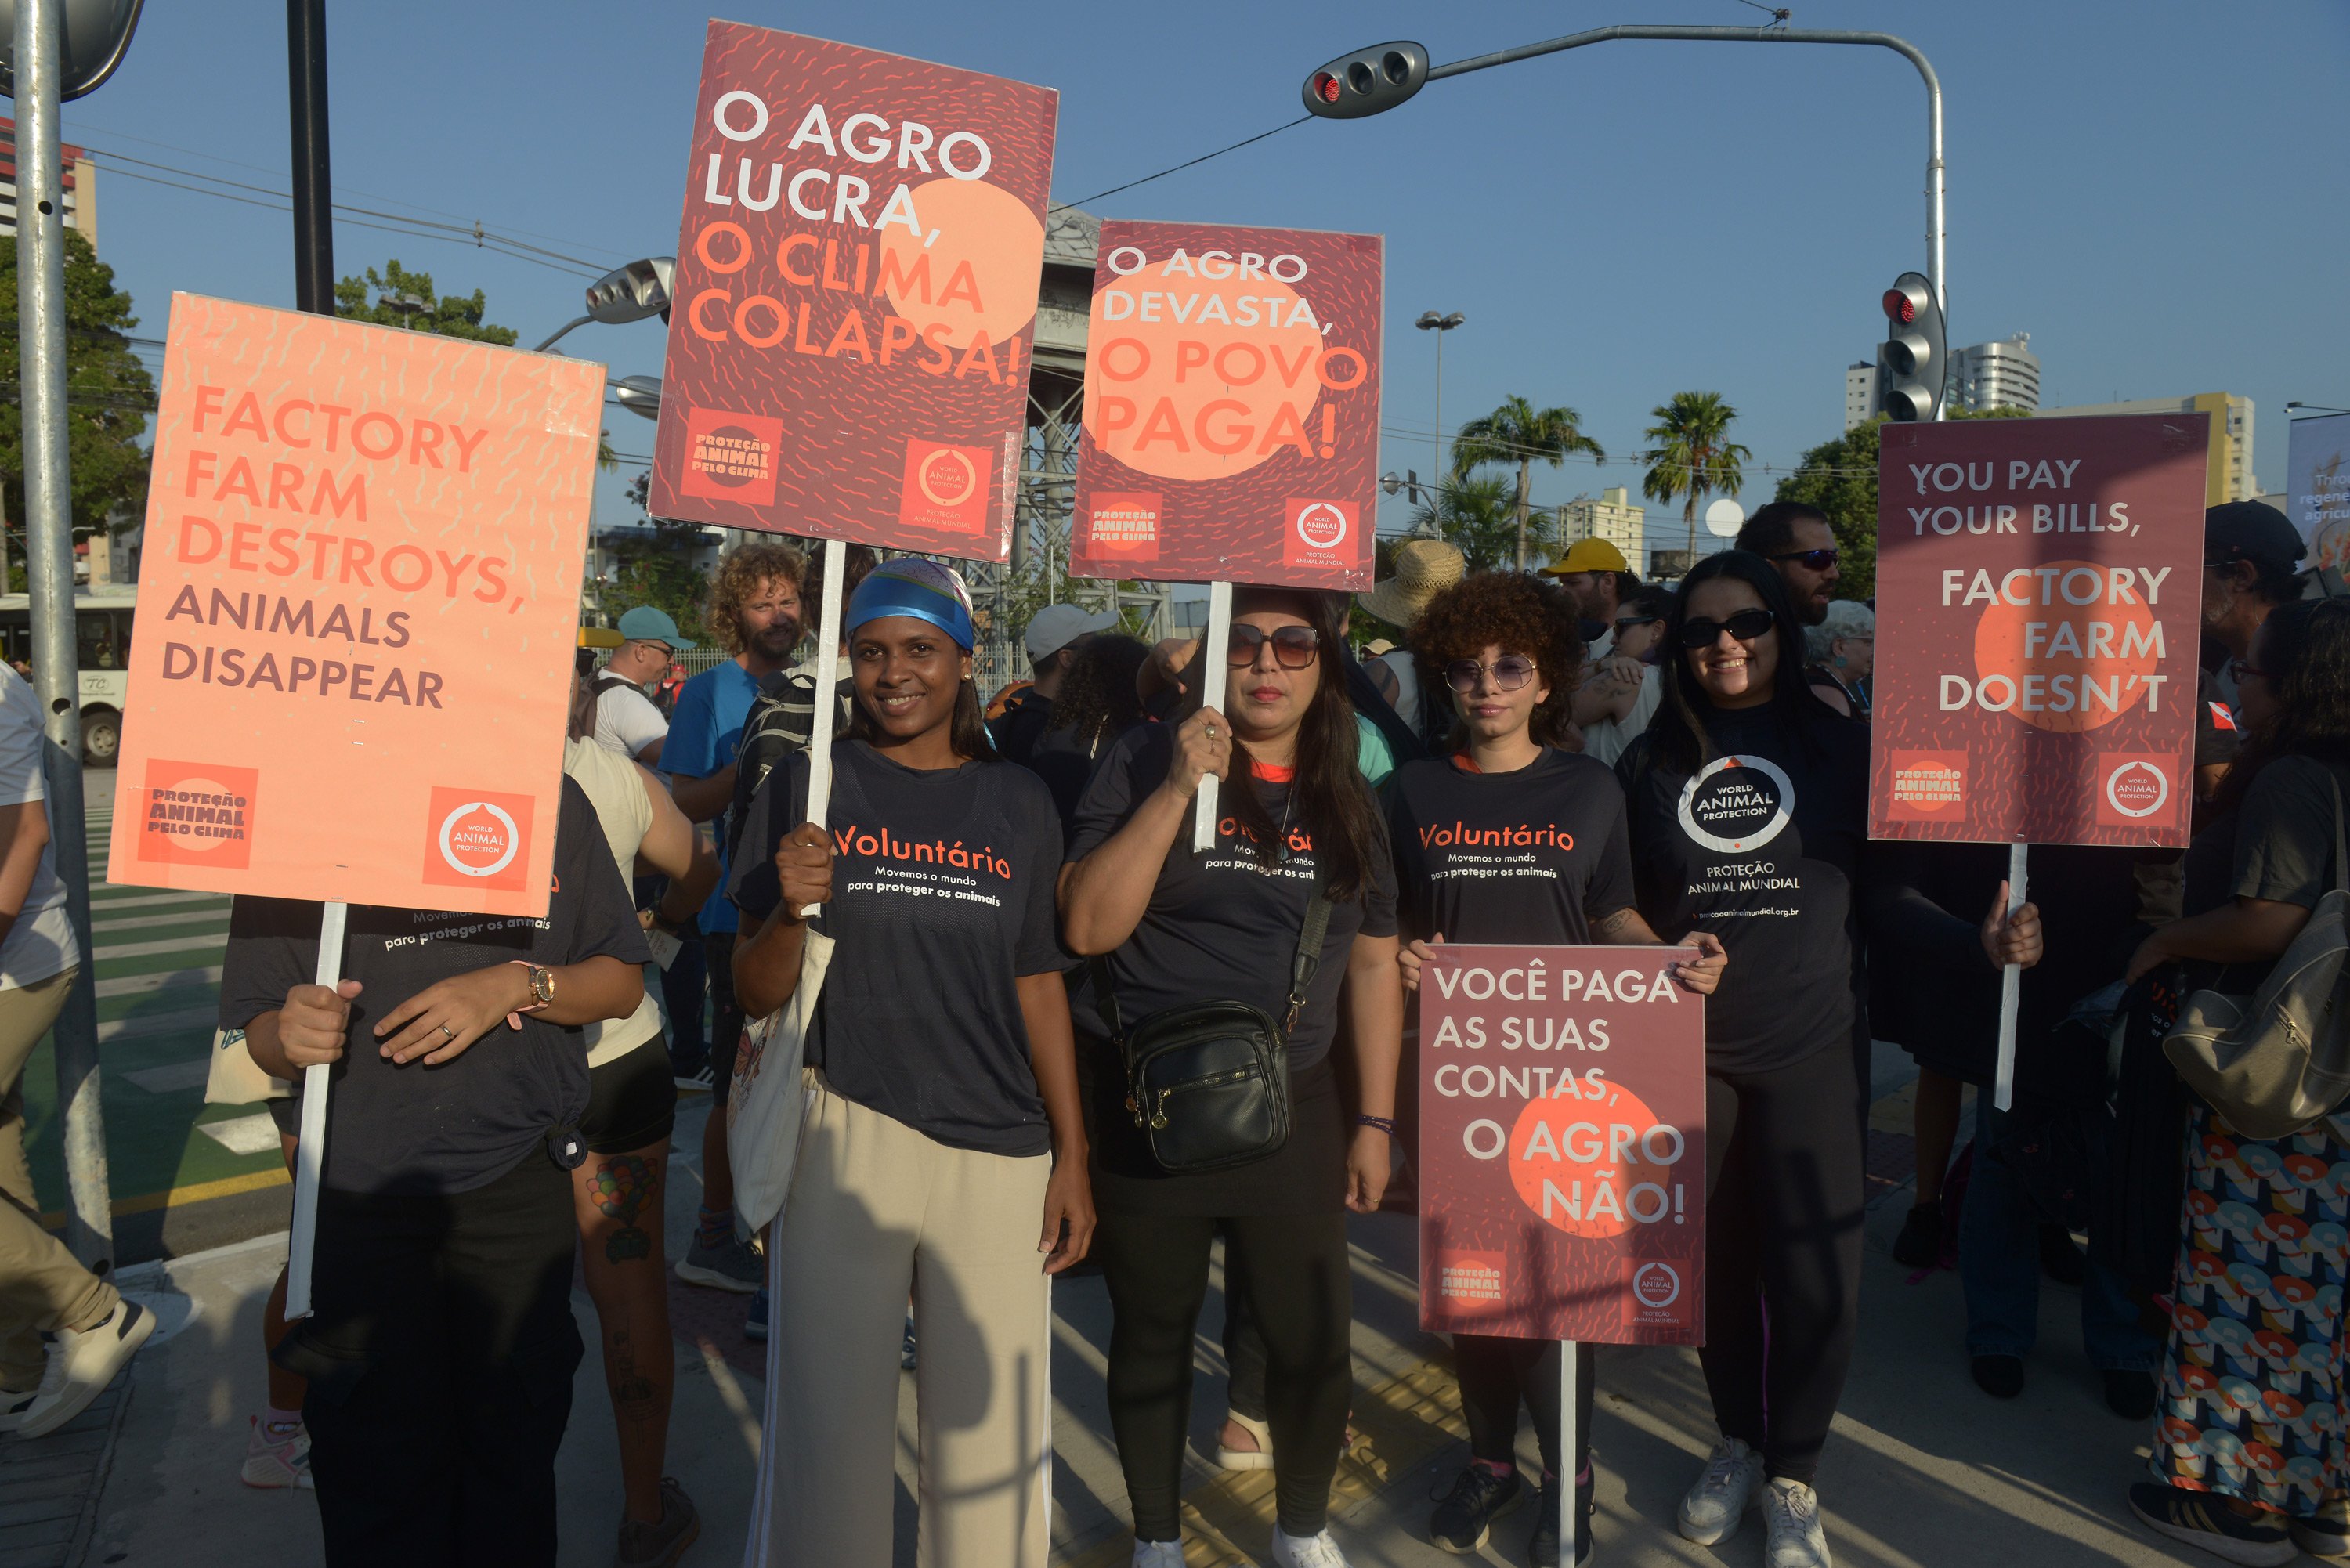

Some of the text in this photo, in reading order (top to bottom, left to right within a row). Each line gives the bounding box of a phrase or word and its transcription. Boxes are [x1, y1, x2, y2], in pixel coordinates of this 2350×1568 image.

[713, 90, 992, 180] O AGRO
[705, 154, 940, 247] LUCRA,
[696, 222, 984, 313] O CLIMA
[1108, 246, 1308, 283] O AGRO
[1103, 291, 1333, 335] DEVASTA,
[689, 288, 1021, 387] COLAPSA!
[1098, 338, 1367, 390] O POVO
[192, 385, 490, 474] FACTORY
[1095, 396, 1335, 460] PAGA!
[696, 434, 771, 453] PROTEÇÃO
[692, 446, 768, 468] ANIMAL
[692, 461, 768, 480] PELO CLIMA
[929, 471, 966, 483] ANIMAL
[1908, 459, 2081, 493] YOU PAY
[184, 450, 367, 521] FARM
[914, 516, 971, 529] ANIMAL MUNDIAL
[927, 509, 960, 519] PROTEÇÃO
[1093, 521, 1155, 532] ANIMAL
[1094, 510, 1156, 521] PROTEÇÃO
[1907, 502, 2142, 537] YOUR BILLS,
[177, 515, 525, 615] DESTROYS,
[1942, 566, 2172, 607] FACTORY
[164, 584, 410, 648] ANIMALS
[2024, 620, 2167, 659] FARM
[162, 641, 443, 710] DISAPPEAR
[1940, 674, 2167, 713] DOESN'T
[1895, 780, 1960, 792] ANIMAL
[1896, 768, 1961, 780] PROTEÇÃO
[152, 789, 247, 808] PROTEÇÃO
[1697, 792, 1773, 811] ANIMAL
[1717, 784, 1754, 795] WORLD
[150, 803, 244, 826] ANIMAL
[1703, 807, 1767, 821] PROTECTION
[147, 822, 244, 840] PELO CLIMA
[454, 832, 504, 846] ANIMAL
[1419, 821, 1574, 851] Voluntário
[457, 844, 500, 853] PROTECTION
[834, 825, 1011, 880] Voluntário
[1448, 853, 1492, 862] Movemos
[1504, 852, 1536, 862] mundo
[875, 865, 977, 887] Movemos o mundo
[1206, 860, 1231, 869] para
[1430, 871, 1448, 883] para
[1450, 868, 1498, 879] proteger
[1516, 866, 1557, 879] animais
[1706, 861, 1775, 878] PROTEÇÃO
[848, 881, 1000, 907] para proteger os animais
[1688, 877, 1800, 895] ANIMAL MUNDIAL
[385, 935, 415, 952] para
[419, 923, 483, 945] proteger
[487, 920, 503, 931] os
[1433, 957, 1679, 1003] VOCÊ PAGA
[1433, 1015, 1611, 1052] AS SUAS
[1434, 1064, 1619, 1107] CONTAS,
[1462, 1118, 1684, 1165] O AGRO
[1542, 1169, 1685, 1224] NÃO!
[1441, 1277, 1501, 1290] ANIMAL
[1441, 1288, 1501, 1299] PELO CLIMA
